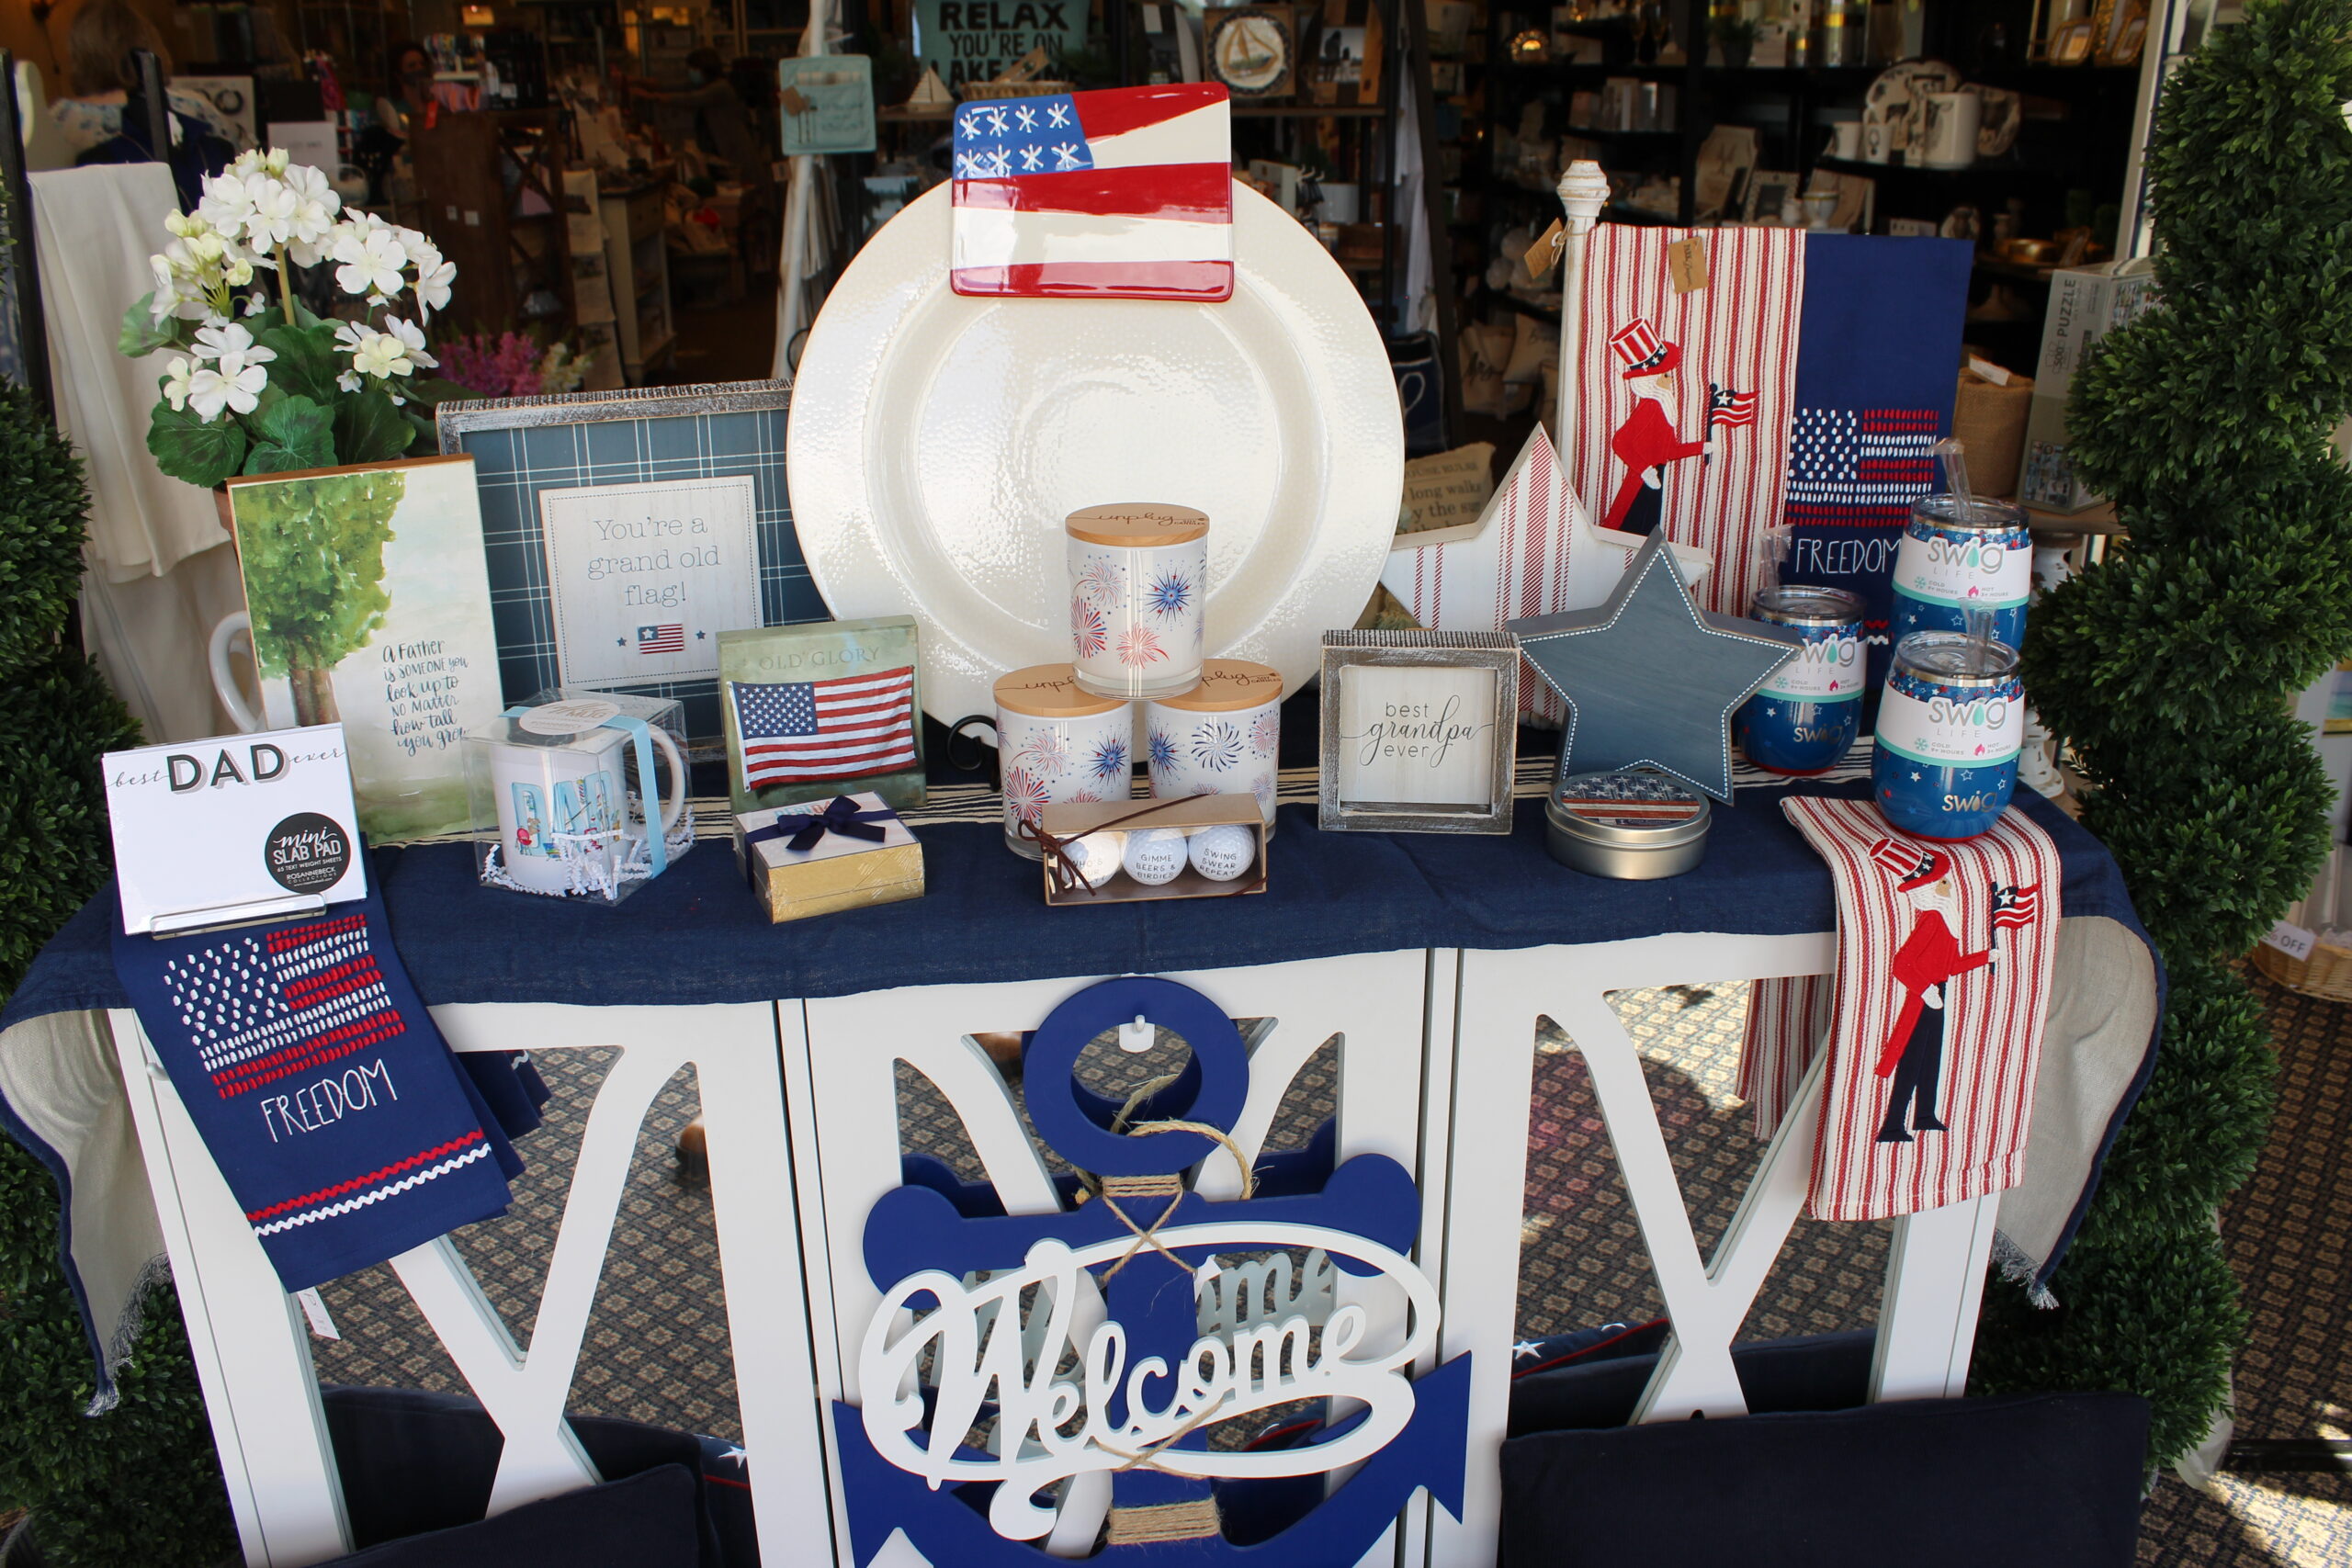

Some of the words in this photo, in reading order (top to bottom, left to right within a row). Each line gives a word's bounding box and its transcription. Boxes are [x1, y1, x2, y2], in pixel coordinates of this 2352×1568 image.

[939, 2, 1069, 31] RELAX
[949, 31, 1025, 57] YOU'RE
[2057, 279, 2076, 337] PUZZLE
[1408, 487, 1442, 501] long
[1429, 502, 1456, 517] the
[594, 516, 684, 541] You're
[691, 517, 708, 535] a
[588, 549, 673, 581] grand
[680, 546, 721, 569] old
[1795, 538, 1901, 574] FREEDOM
[1928, 538, 2005, 574] swig
[1933, 567, 1975, 580] LIFE
[625, 581, 686, 608] flag!
[399, 640, 446, 660] Father
[759, 653, 802, 671] OLD
[811, 647, 880, 667] GLORY
[384, 667, 396, 682] is
[399, 658, 447, 679] SOMEONE
[448, 656, 469, 672] you
[1202, 671, 1250, 687] plug
[1795, 667, 1836, 675] LIFE
[386, 682, 418, 703] look
[421, 680, 442, 697] up
[443, 675, 459, 690] to
[1022, 676, 1075, 693] unpl
[412, 694, 459, 714] Matter
[1385, 702, 1430, 718] best
[1928, 699, 2007, 730] swig
[390, 719, 424, 736] how
[424, 708, 458, 728] tall
[1343, 695, 1491, 768] grandpa
[1793, 724, 1844, 743] swig
[1937, 728, 1981, 739] LIFE
[398, 736, 434, 758] you
[1385, 743, 1430, 758] ever
[106, 770, 168, 788] best
[167, 743, 288, 793] DAD
[289, 748, 345, 764] ever
[1941, 790, 1997, 813] swig
[273, 827, 337, 848] mini
[273, 845, 310, 865] SLAB
[313, 840, 342, 858] PAD
[299, 860, 322, 868] WEIGHT
[322, 856, 343, 864] SHEETS
[1140, 854, 1172, 863] GIMME
[1202, 857, 1236, 869] SWEAR
[1204, 848, 1237, 861] SWING
[1136, 863, 1165, 872] BEERS
[1200, 865, 1235, 876] REPEAT
[2280, 935, 2306, 953] OFF
[260, 1058, 398, 1143] FREEDOM
[858, 1222, 1441, 1541] Welcome
